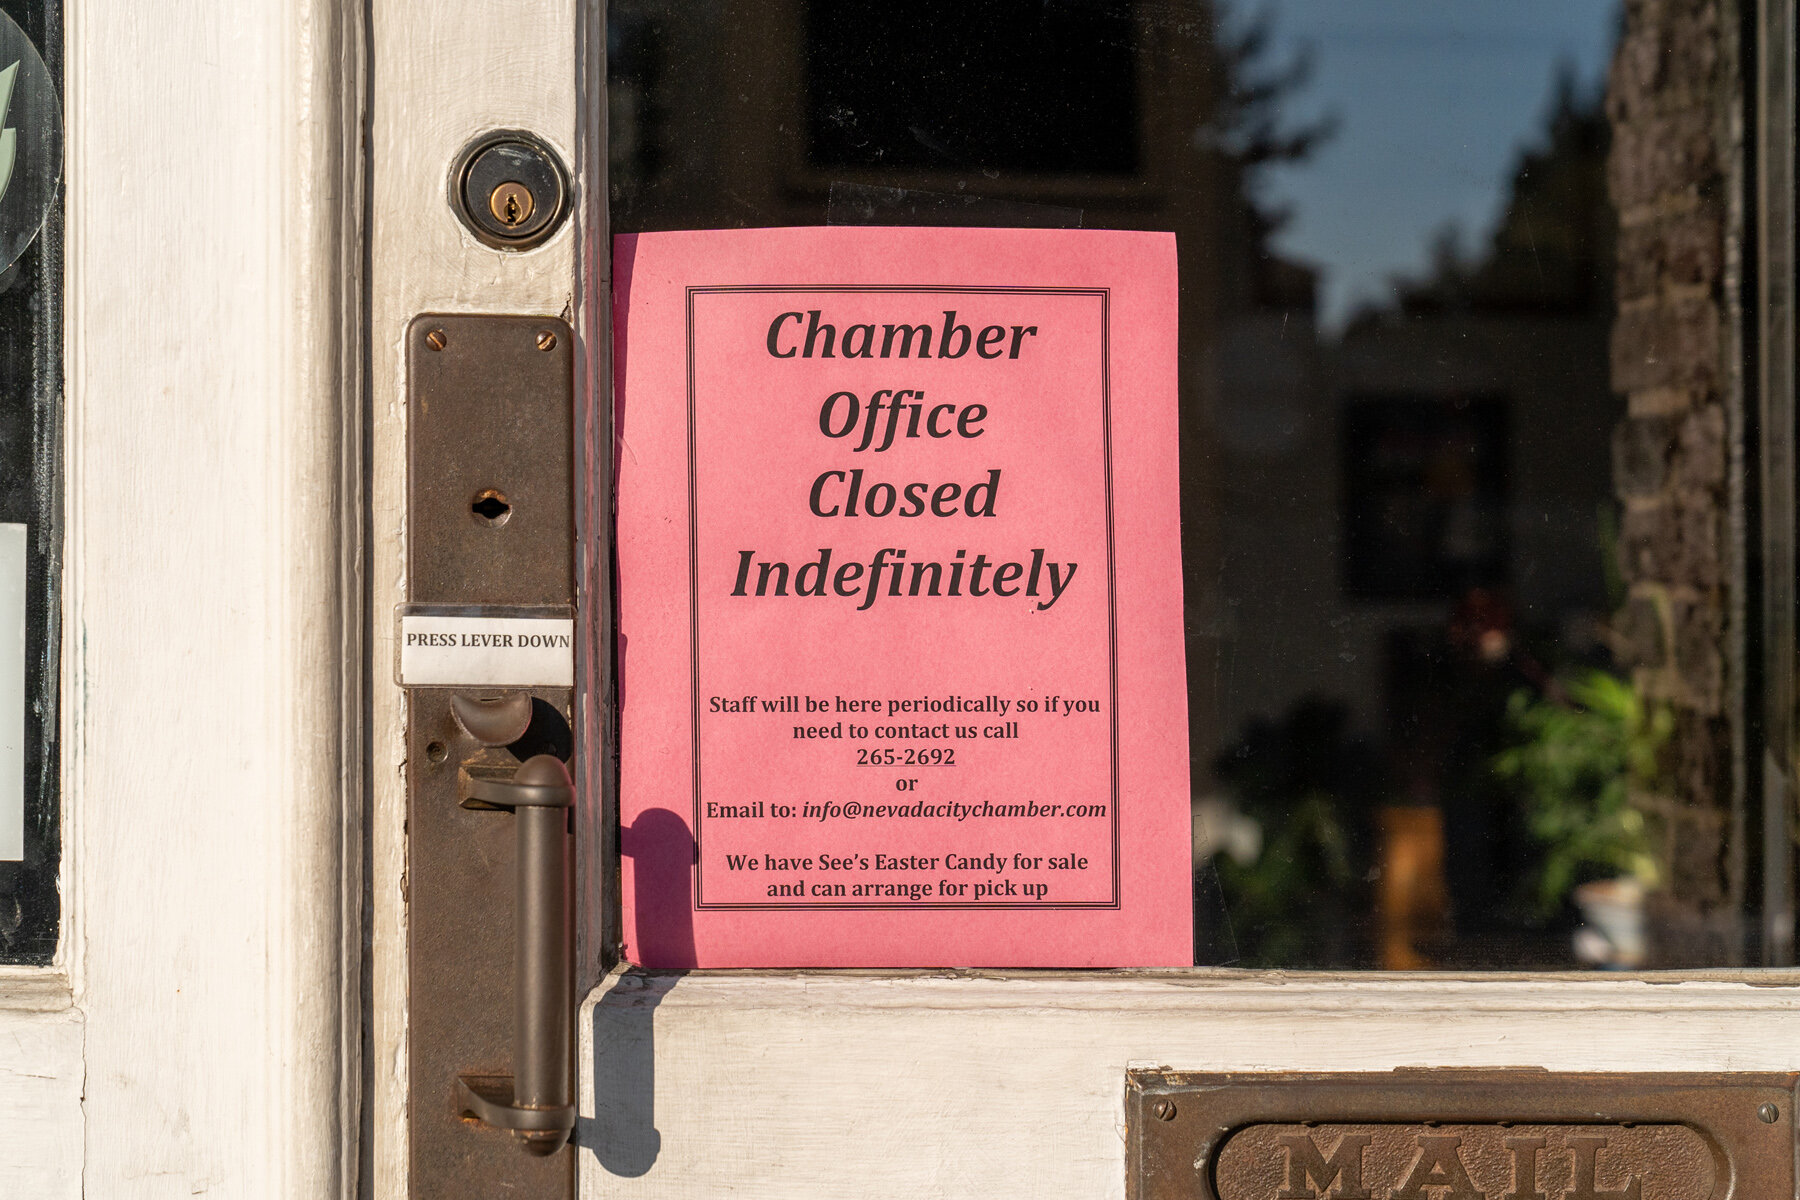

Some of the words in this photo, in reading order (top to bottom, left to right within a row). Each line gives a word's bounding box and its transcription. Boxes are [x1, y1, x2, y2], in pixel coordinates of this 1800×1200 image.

[767, 310, 1038, 359] Chamber
[820, 390, 987, 452] Office
[810, 469, 1001, 517] Closed
[731, 549, 1077, 610] Indefinitely
[407, 633, 457, 647] PRESS
[461, 634, 513, 648] LEVER
[517, 634, 571, 649] DOWN
[709, 695, 758, 713] Staff
[761, 695, 799, 713] will
[805, 695, 830, 713] be
[835, 695, 882, 713] here
[887, 695, 1011, 717] periodically
[1016, 699, 1039, 713] so
[1044, 695, 1060, 713] if
[1063, 699, 1100, 717] you
[792, 721, 843, 739] need
[848, 723, 869, 739] to
[874, 723, 950, 739] contact
[954, 726, 978, 739] us
[983, 721, 1019, 739] call
[857, 748, 955, 766] 265-2692
[895, 778, 919, 792] or
[706, 801, 765, 818] Email
[770, 803, 796, 818] to:
[802, 800, 1106, 823] info@nevadacitychamber.com
[726, 854, 759, 871] We
[764, 853, 813, 871] have
[875, 854, 940, 871] Easter
[945, 852, 1008, 875] Candy
[1013, 852, 1043, 870] for
[1048, 853, 1089, 870] sale
[767, 879, 805, 897] and
[811, 884, 847, 897] can
[851, 883, 934, 901] arrange
[938, 879, 969, 897] for
[973, 879, 1019, 901] pick
[1022, 883, 1049, 901] up
[1279, 1134, 1642, 1200] MAIL
